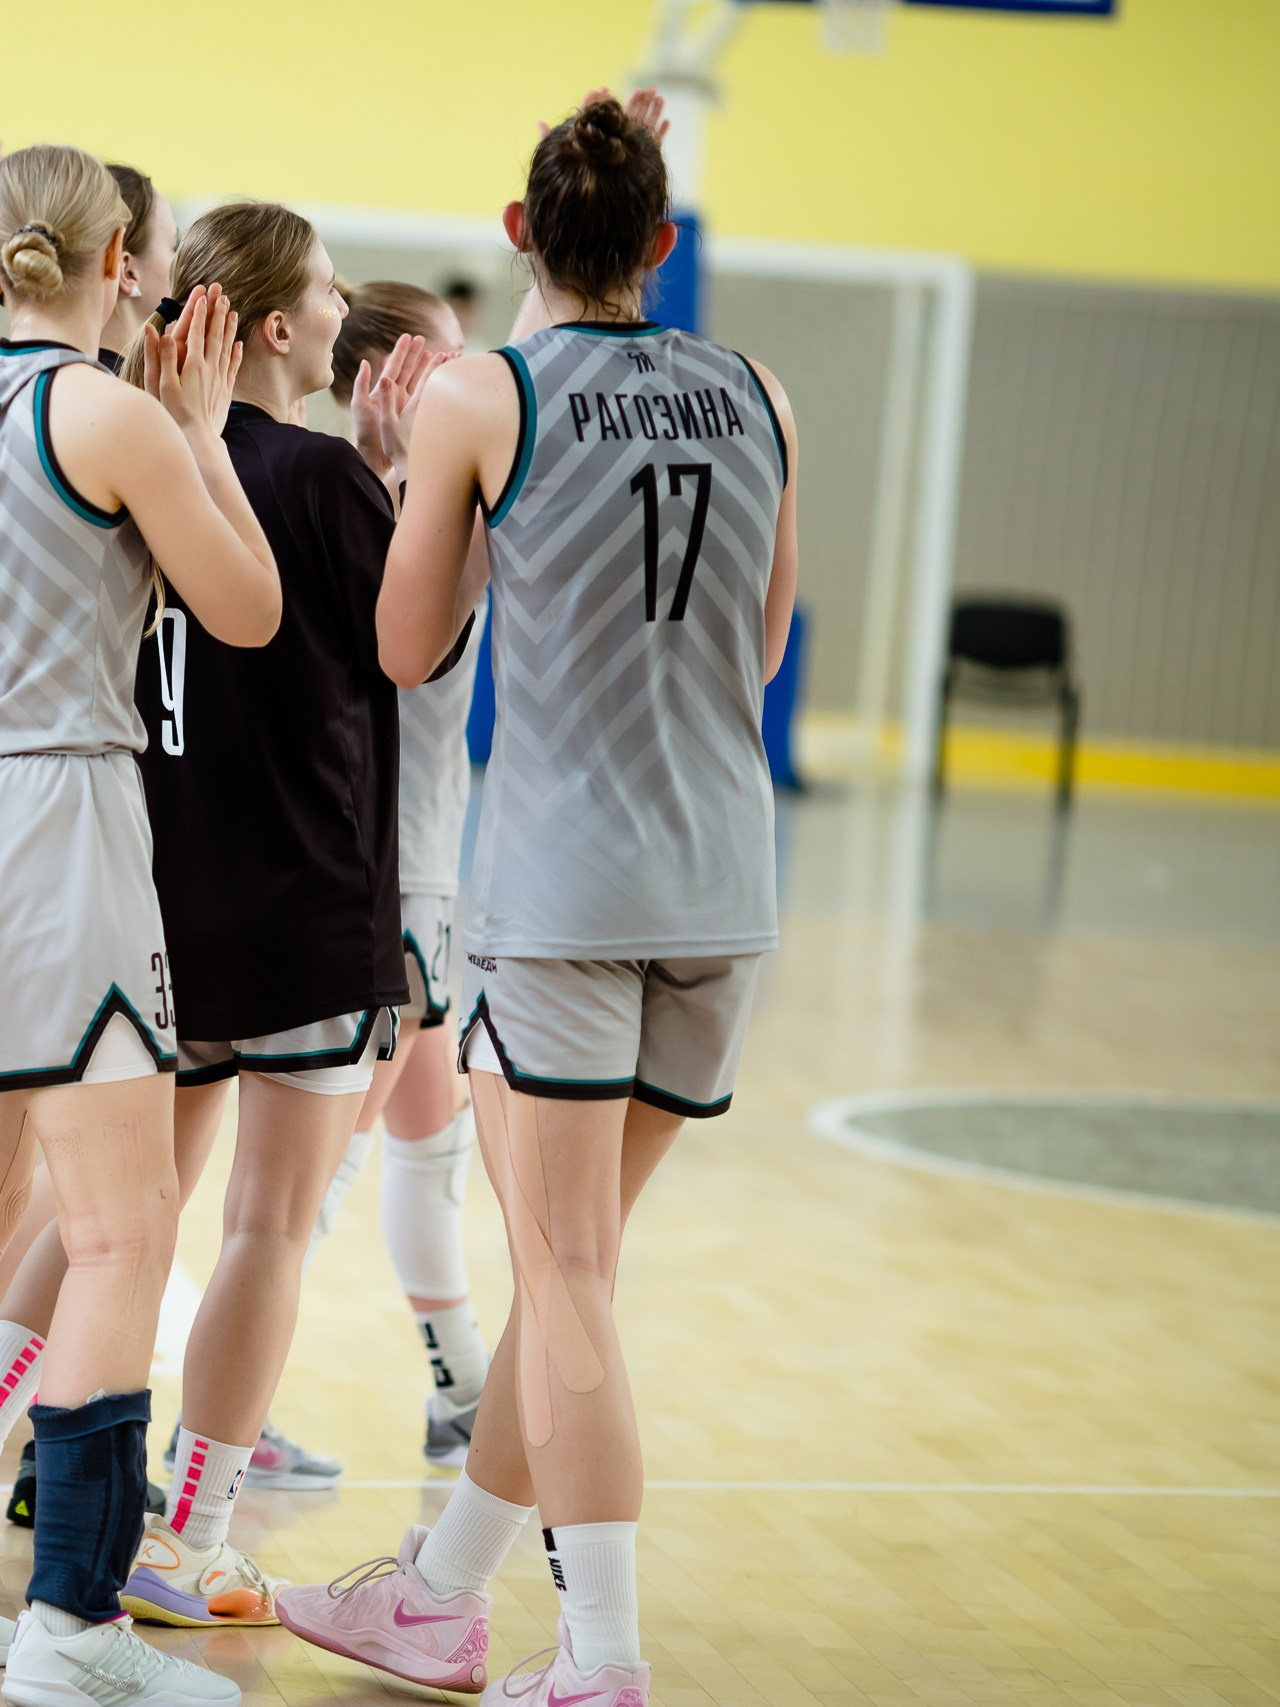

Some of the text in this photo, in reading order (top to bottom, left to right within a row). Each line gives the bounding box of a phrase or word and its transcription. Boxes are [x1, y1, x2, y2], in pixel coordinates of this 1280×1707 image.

[568, 387, 745, 442] РАГОЗИНА
[630, 462, 713, 622] 17
[154, 607, 187, 756] 9
[151, 951, 176, 1029] 3
